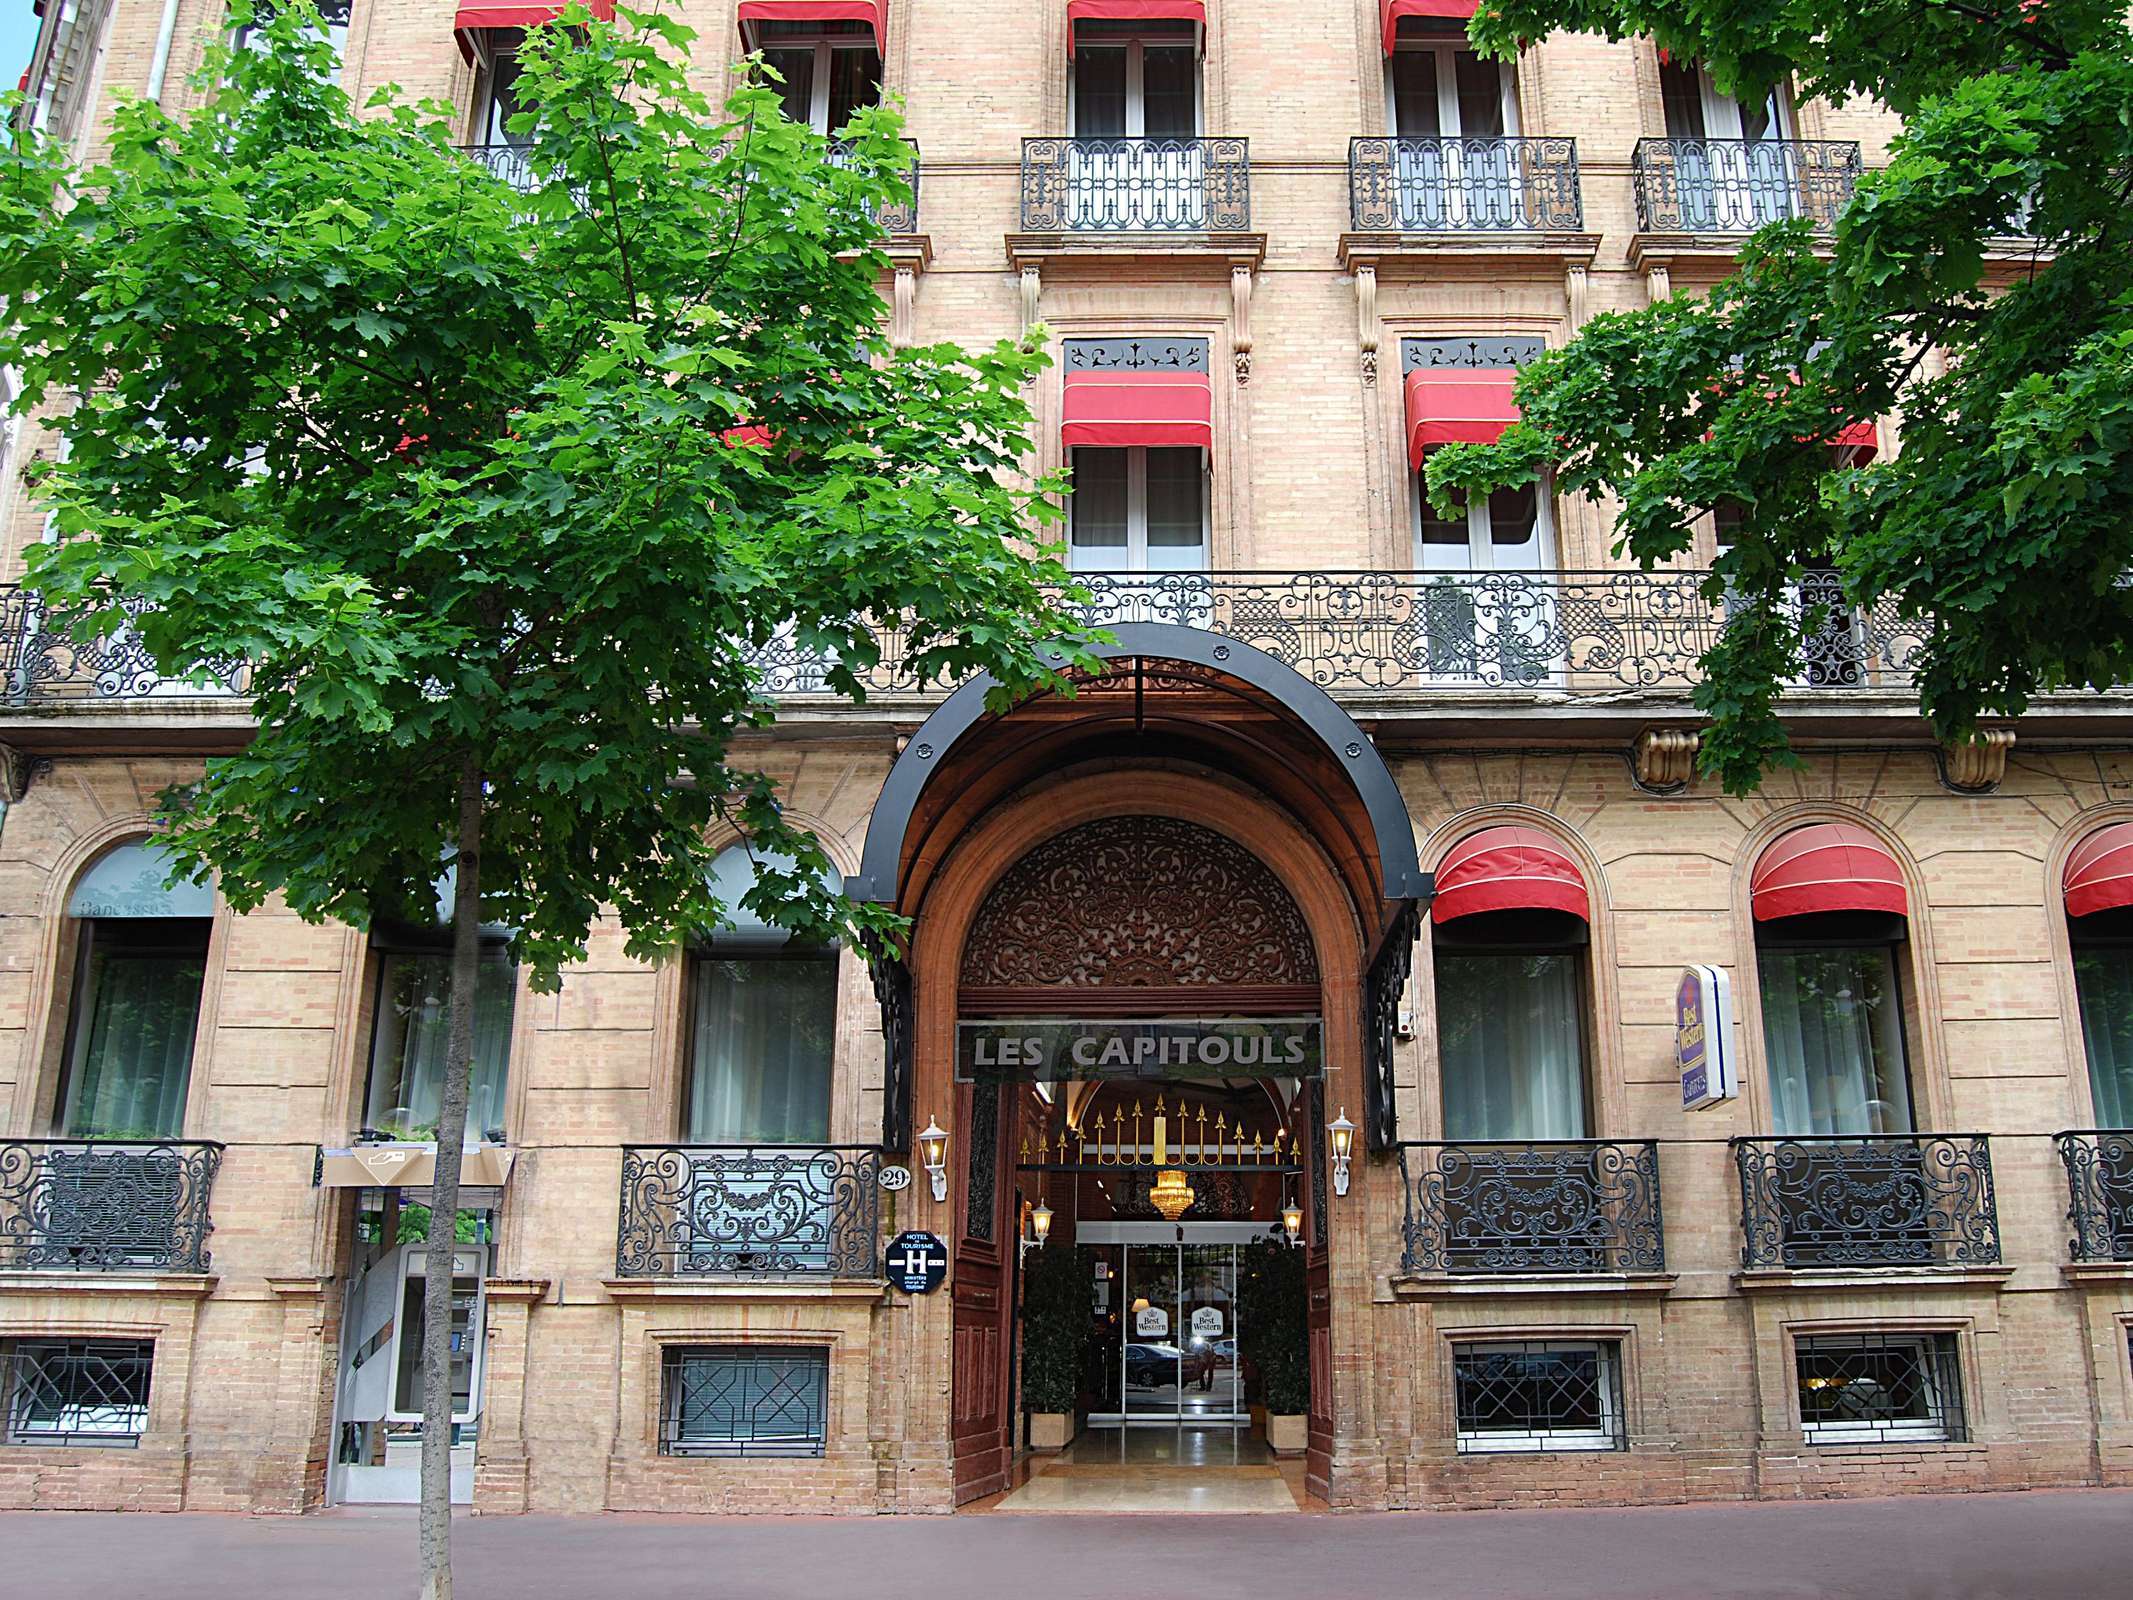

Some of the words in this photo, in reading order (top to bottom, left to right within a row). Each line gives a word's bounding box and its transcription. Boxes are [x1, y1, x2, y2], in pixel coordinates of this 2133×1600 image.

[1683, 1003, 1697, 1025] Best
[1679, 1023, 1704, 1051] Western
[974, 1038, 1043, 1066] LES
[1072, 1035, 1306, 1066] CAPITOULS
[884, 1170, 906, 1186] 29
[906, 1250, 927, 1274] H
[1138, 1323, 1166, 1331] Western
[1194, 1323, 1221, 1331] Western
